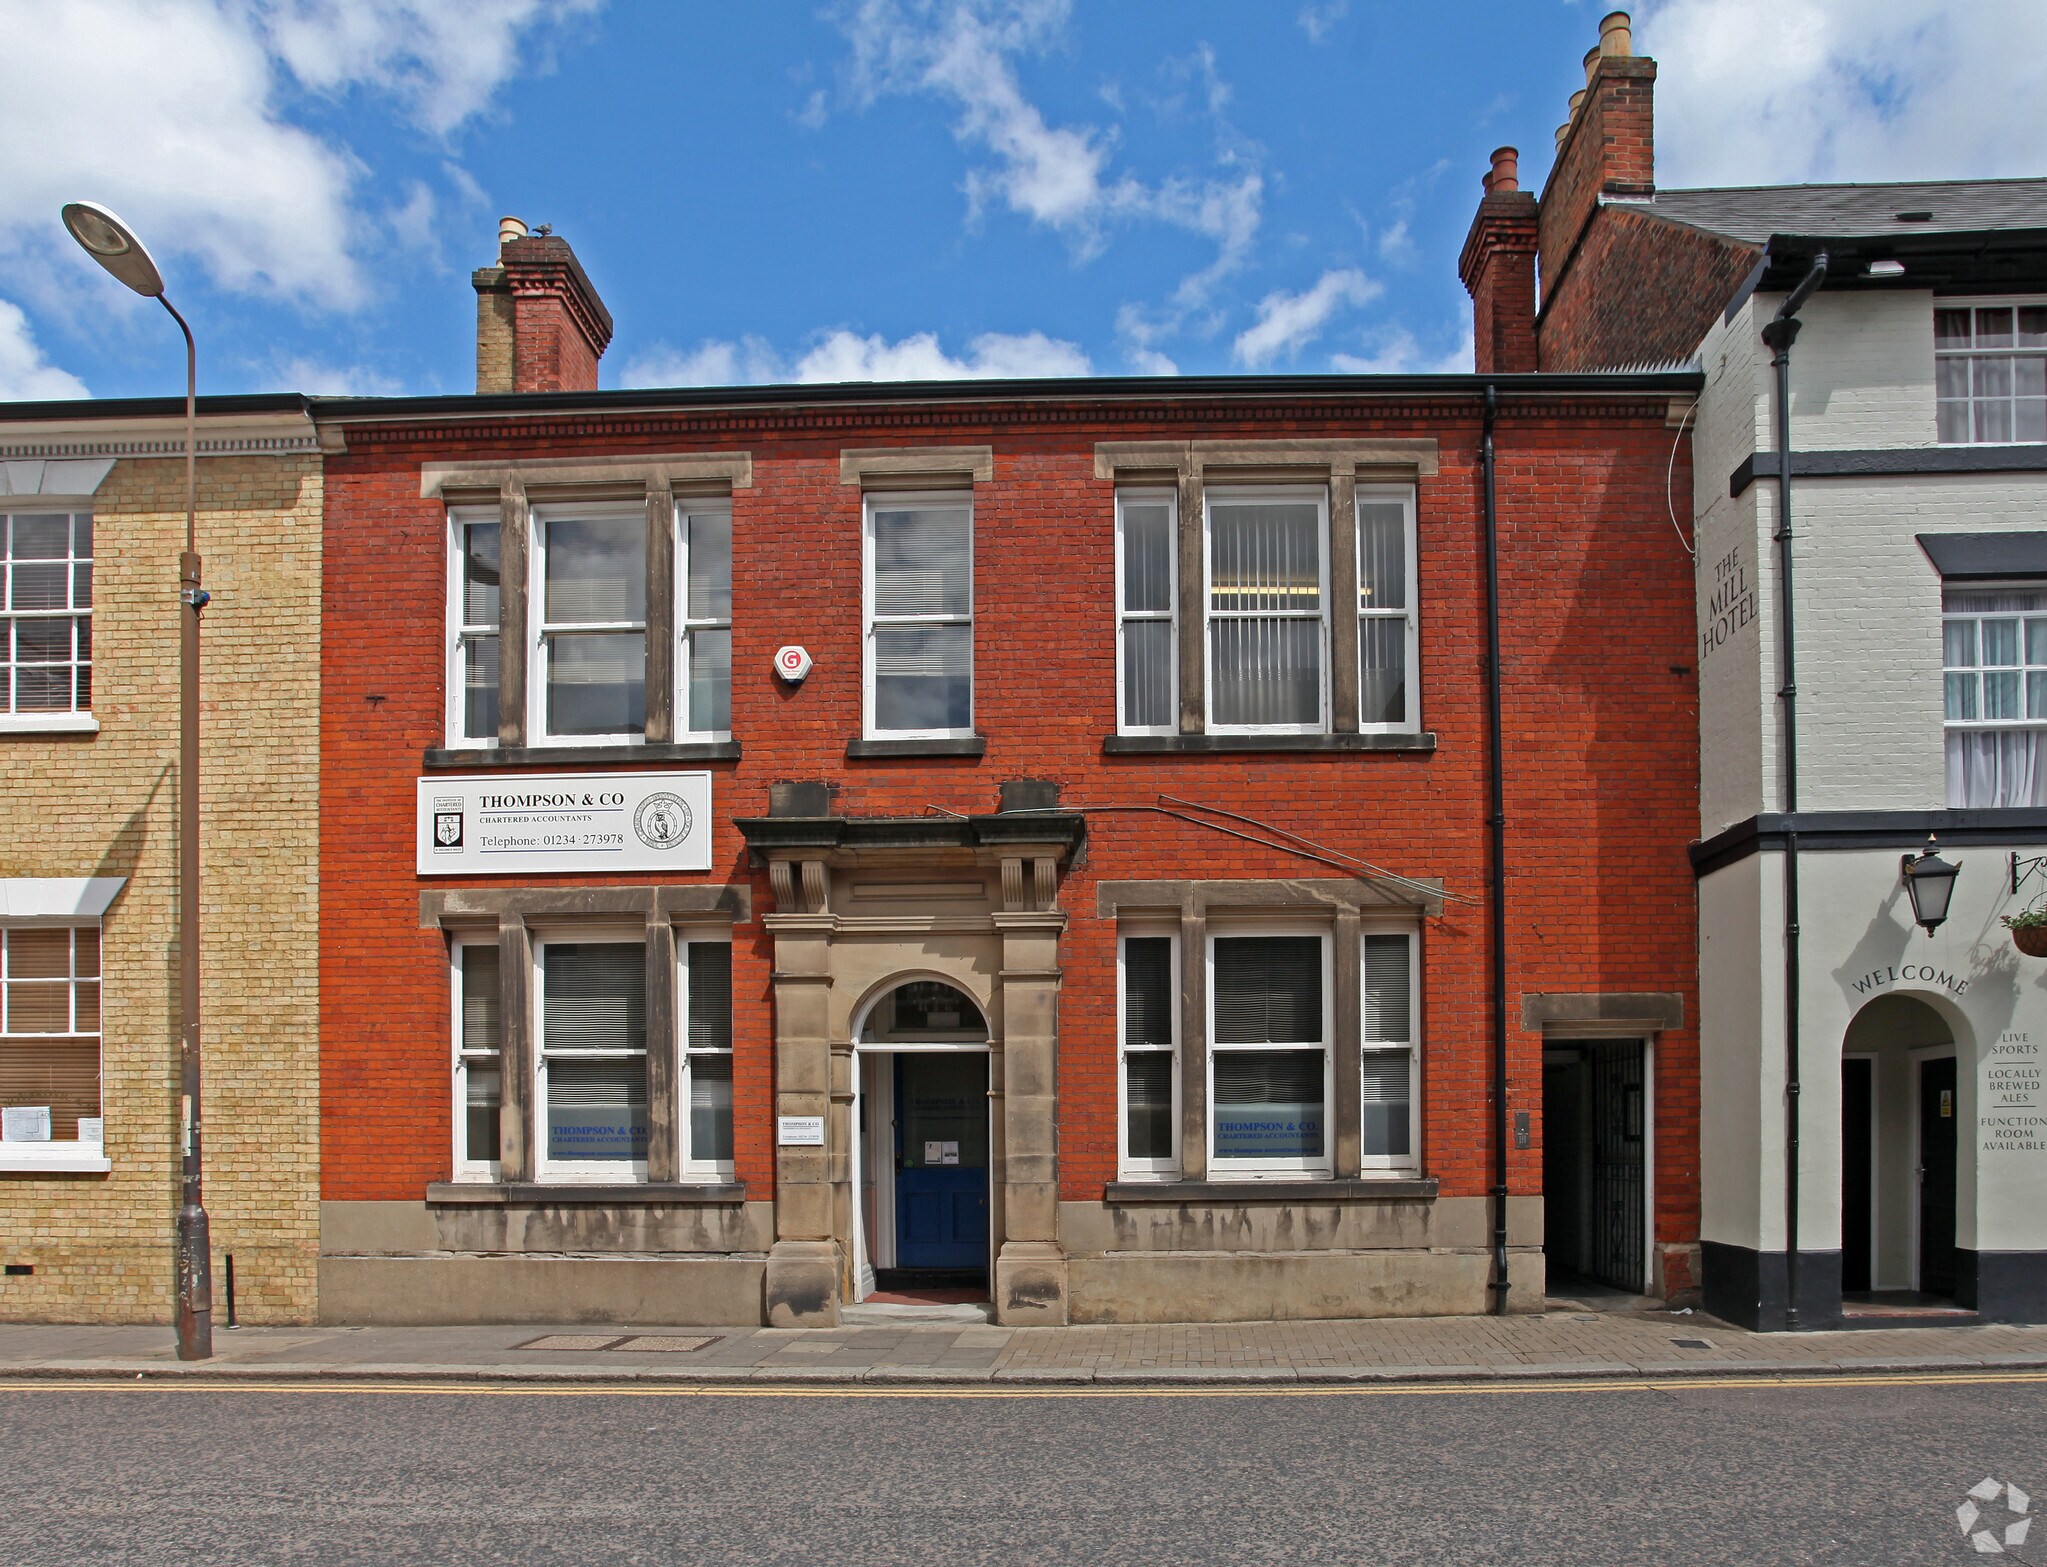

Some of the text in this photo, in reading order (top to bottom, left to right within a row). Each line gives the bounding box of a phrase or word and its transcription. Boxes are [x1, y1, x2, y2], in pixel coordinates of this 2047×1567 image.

[1714, 546, 1738, 582] THE
[1709, 566, 1748, 622] MILL
[1702, 591, 1758, 659] HOTEL
[480, 792, 625, 808] THOMPSON & CO
[531, 815, 592, 823] ACCOUNTANTS
[480, 835, 540, 849] Telephone:
[1852, 965, 1969, 996] WELCOME
[2002, 1033, 2029, 1043] LIVE
[1992, 1045, 2039, 1055] SPORTS
[1988, 1069, 2042, 1079] LOCALLY
[1989, 1081, 2040, 1091] BREWED
[2000, 1094, 2029, 1103] ALES
[1217, 1121, 1319, 1131] THOMPSON & CO.
[1981, 1117, 2047, 1127] FUNCTION
[552, 1126, 615, 1135] THOMPSON
[617, 1126, 626, 1135] &
[1995, 1129, 2034, 1139] ROOM
[1982, 1141, 2046, 1151] AVAILABLE
